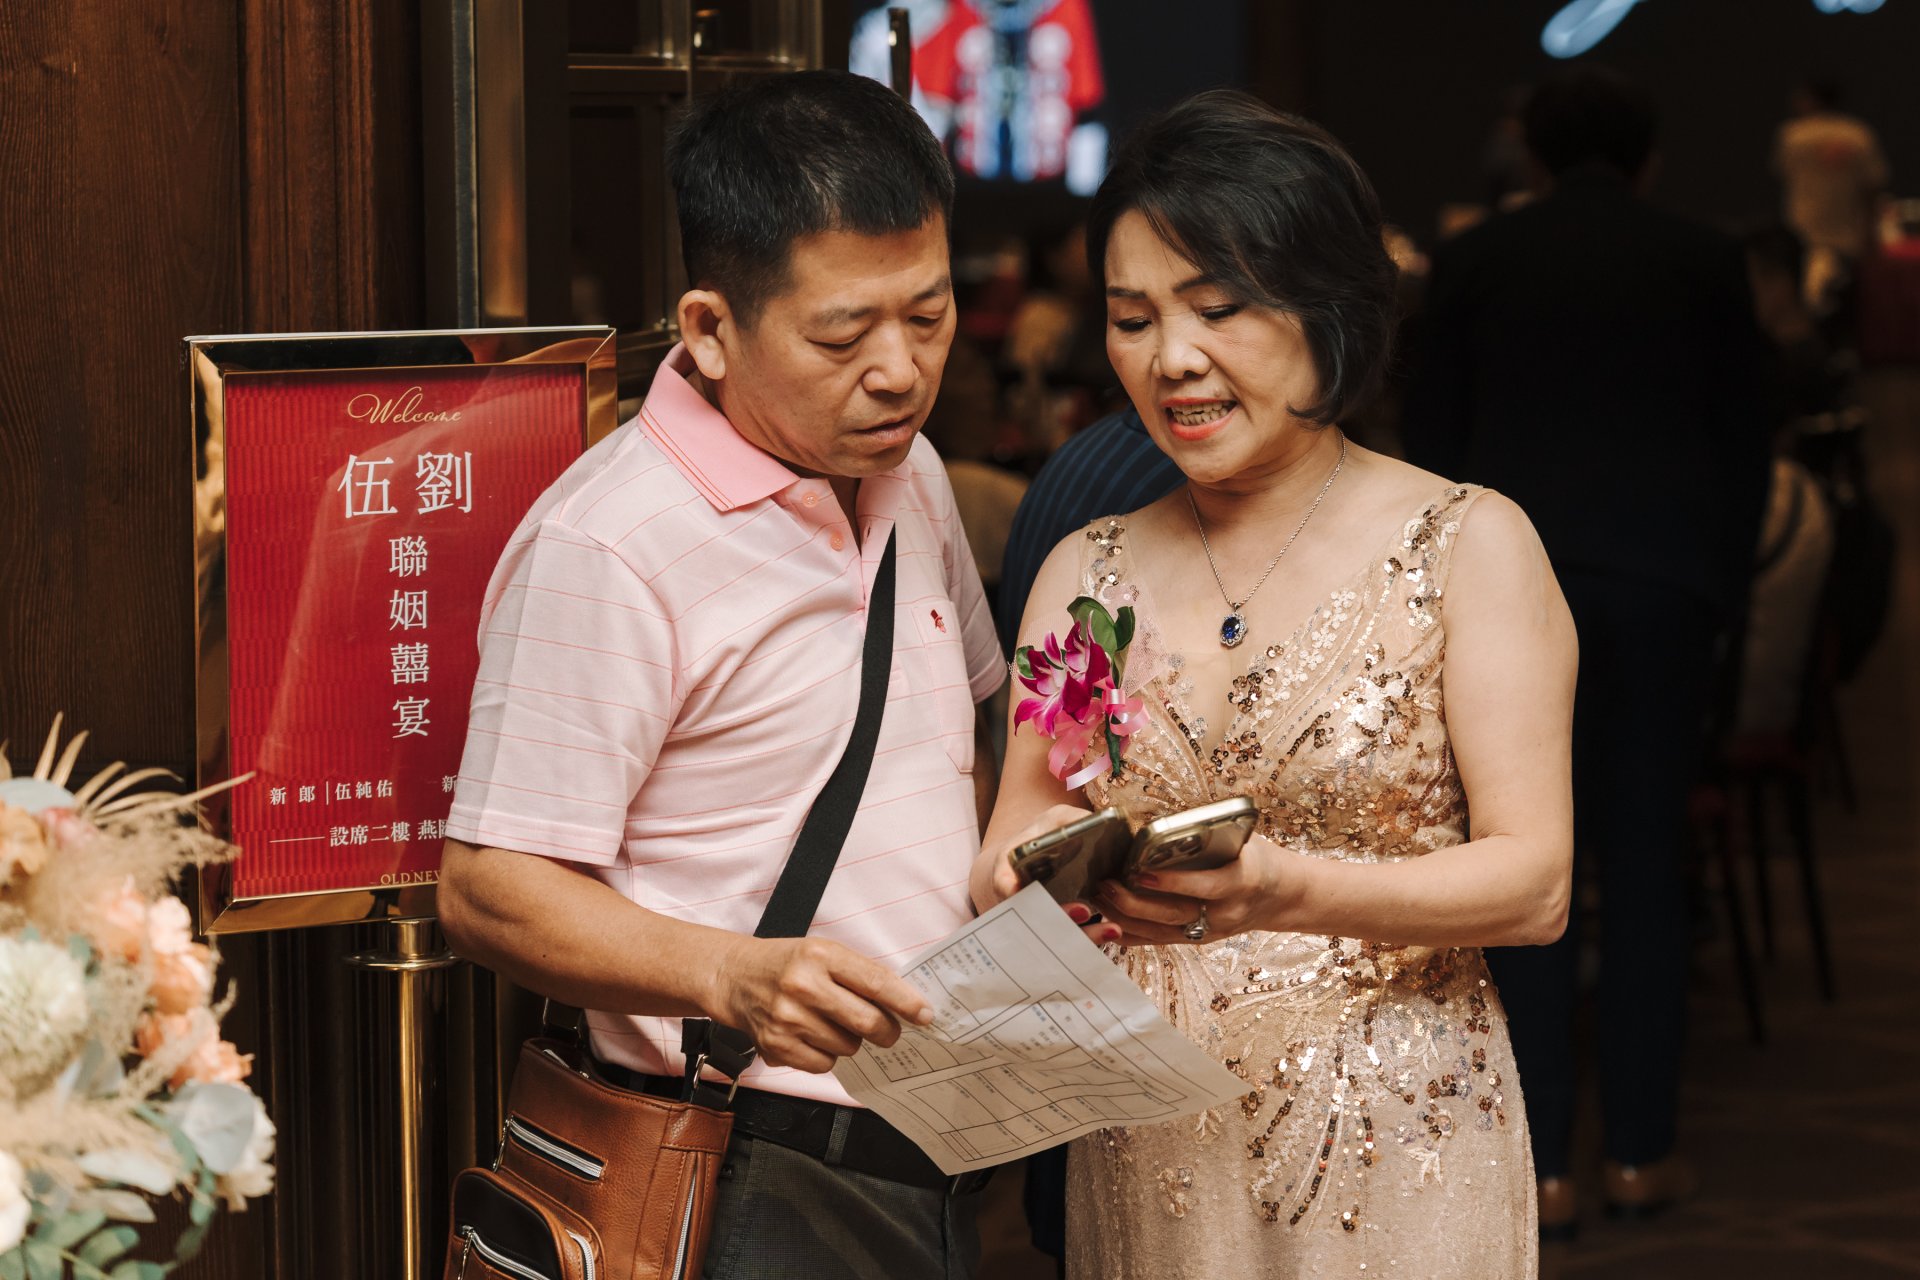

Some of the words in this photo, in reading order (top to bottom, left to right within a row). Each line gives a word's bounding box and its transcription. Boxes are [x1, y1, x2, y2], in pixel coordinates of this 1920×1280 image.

[347, 386, 462, 424] Welcome
[388, 535, 431, 739] 聯姻囍宴
[330, 820, 411, 848] 設席二樓
[380, 872, 411, 885] OLD
